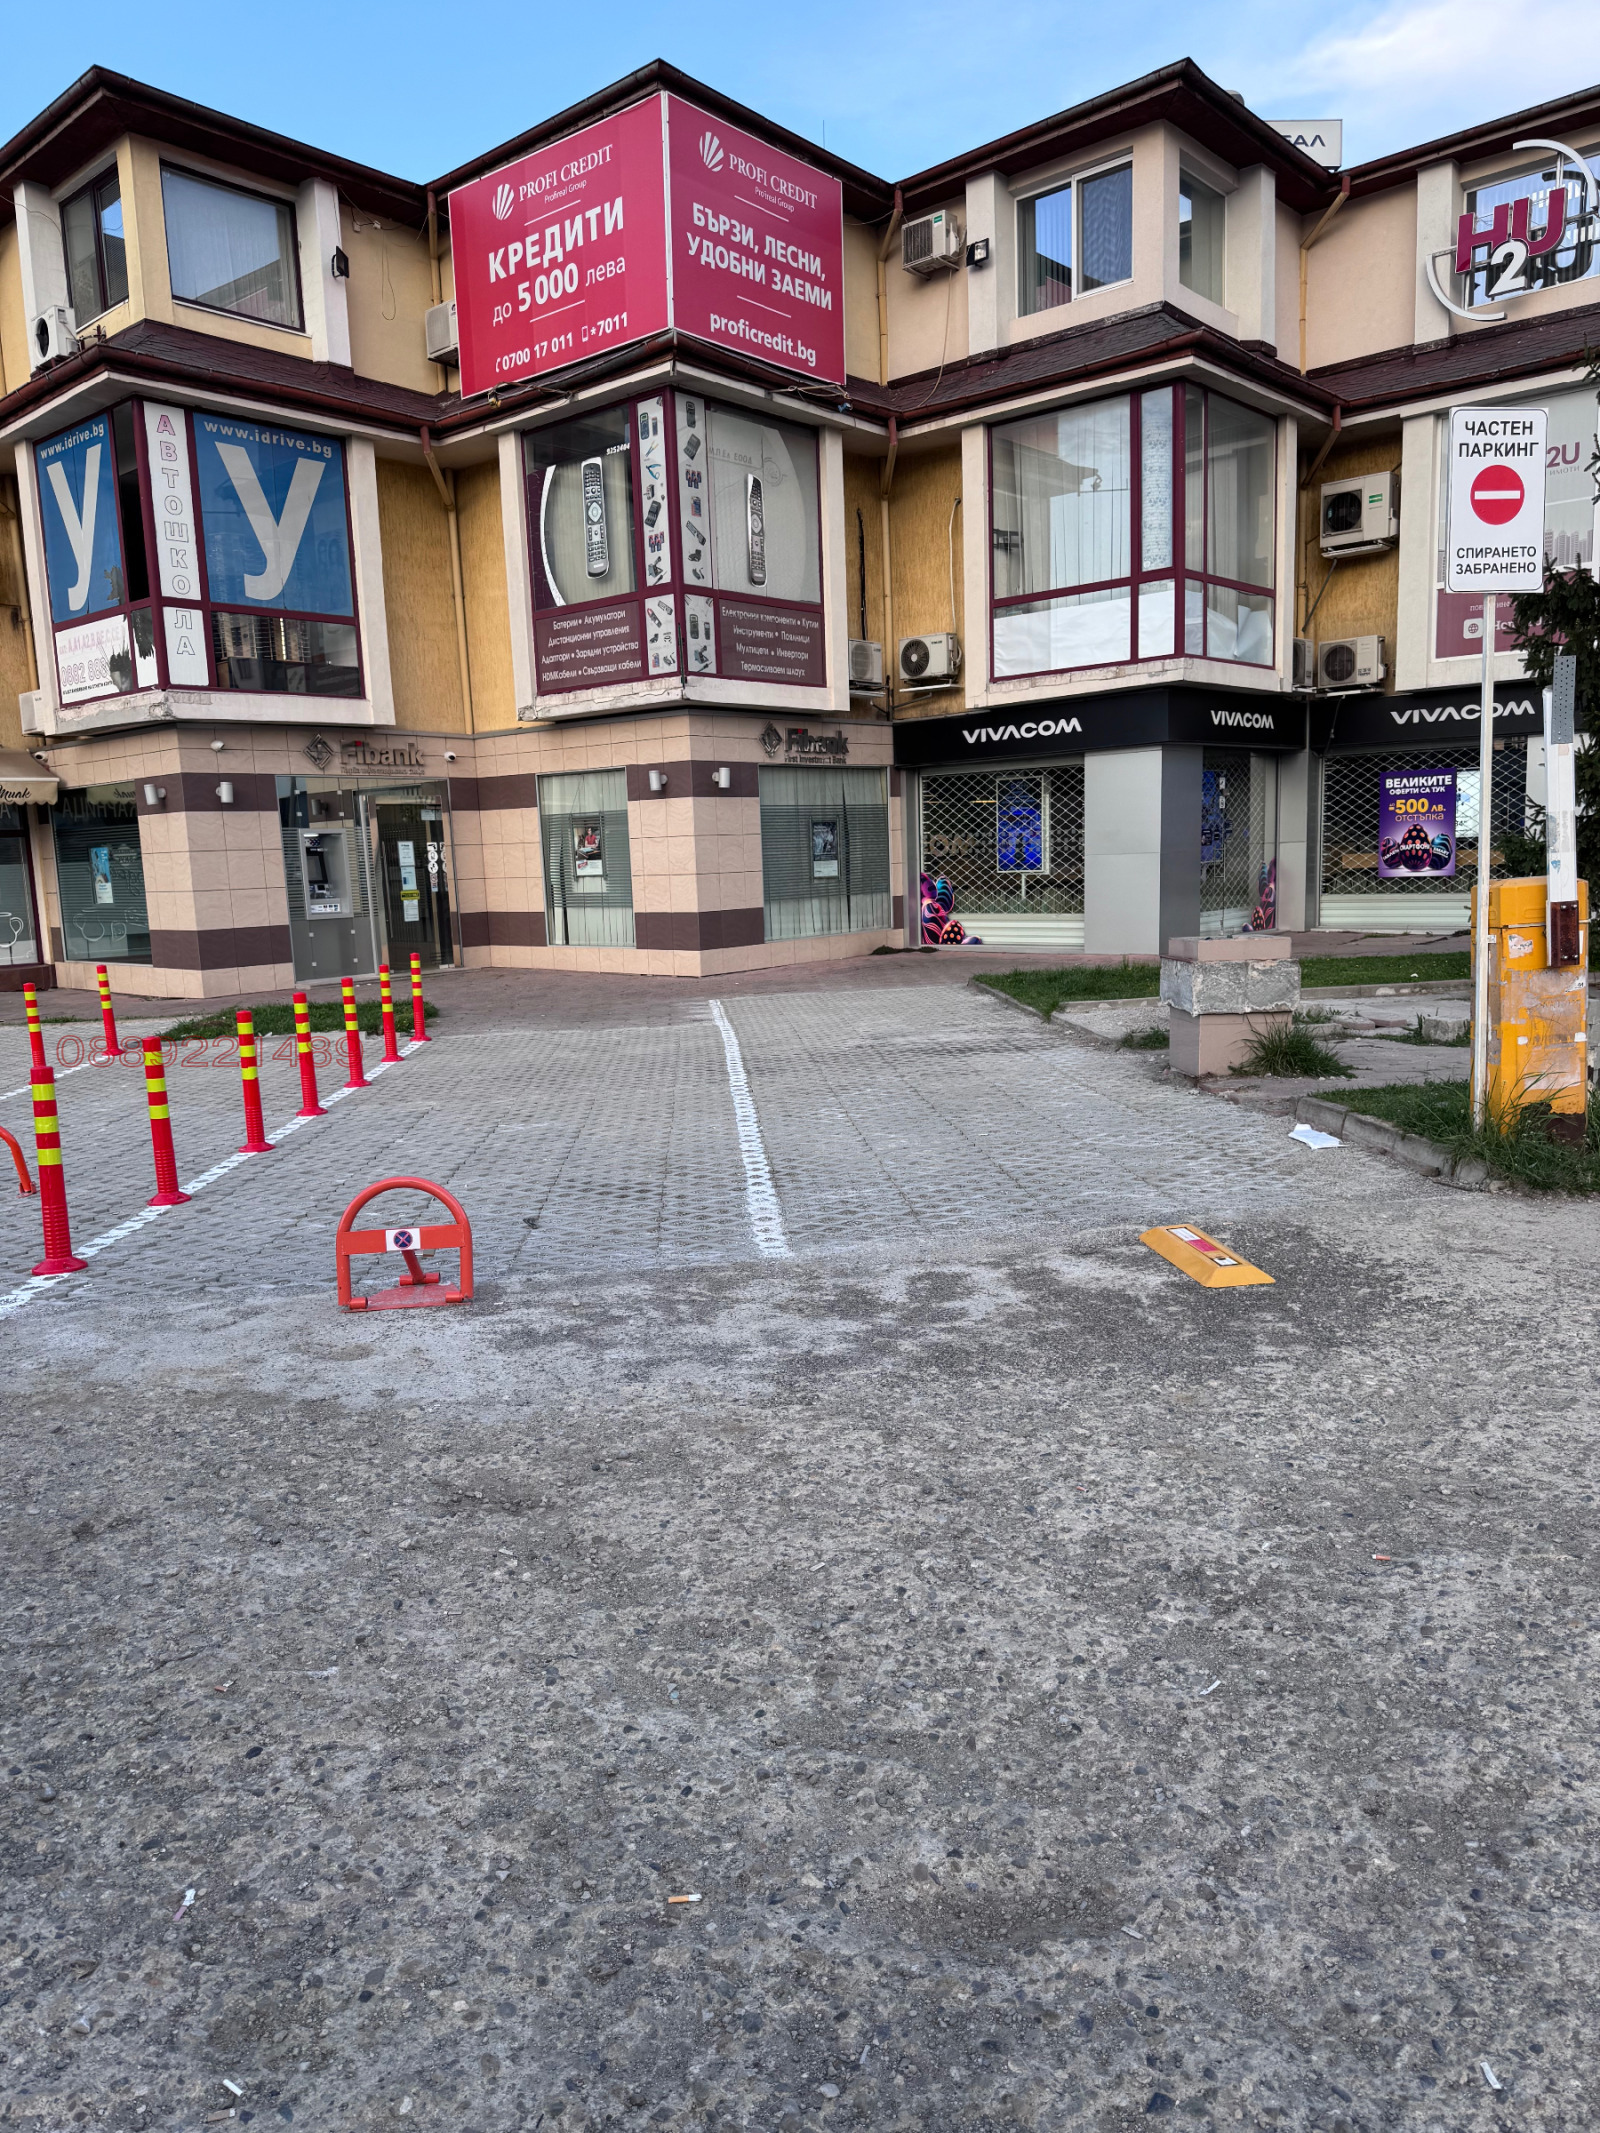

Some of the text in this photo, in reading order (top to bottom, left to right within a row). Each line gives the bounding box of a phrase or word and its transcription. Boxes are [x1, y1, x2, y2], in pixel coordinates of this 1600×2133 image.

[518, 144, 613, 202] PROFI CREDIT
[728, 152, 818, 210] PROFI CREDIT
[544, 179, 587, 204] Profireal Group
[776, 193, 795, 213] Group
[488, 196, 624, 283] КРЕДИТИ
[692, 202, 827, 280] БЪРЗИ, ЛЕСНИ,
[686, 232, 832, 311] УДОБНИ ЗАЕМИ
[493, 302, 512, 327] до
[586, 257, 626, 288] лева
[709, 311, 817, 367] proficredit.bg
[502, 346, 531, 371] 0700
[533, 342, 548, 361] 17
[551, 333, 574, 355] 011
[203, 420, 333, 459] www.idrive.bg
[1465, 420, 1534, 436] ЧАСТЕН
[40, 422, 105, 460] www.idrive.bg
[1459, 442, 1539, 458] ПАРКИНГ
[156, 413, 196, 656] АВТОШКОЛА
[1456, 546, 1537, 560] СПИРАНЕТО
[1455, 562, 1537, 575] ЗАБРАНЕНО
[553, 610, 626, 630] Батерии Акумулатори
[722, 606, 819, 629] Електронни компоненти Кутии
[548, 625, 630, 648] Дистанционни управления
[733, 625, 810, 644] Инструменти Поялници
[541, 641, 639, 664] Адаптори Зарядни устройства
[776, 647, 809, 660] Инвертори
[582, 663, 617, 676] Свързващи
[618, 660, 642, 670] кабели
[786, 667, 806, 677] шлаух
[961, 717, 1083, 745] VIVACOM
[1210, 709, 1275, 730] VIVACOM
[784, 728, 849, 754] Fibank
[341, 741, 424, 766] Fibank
[1385, 775, 1453, 789] ВЕЛИКИТЕ
[1389, 787, 1419, 795] ОФЕРТИ
